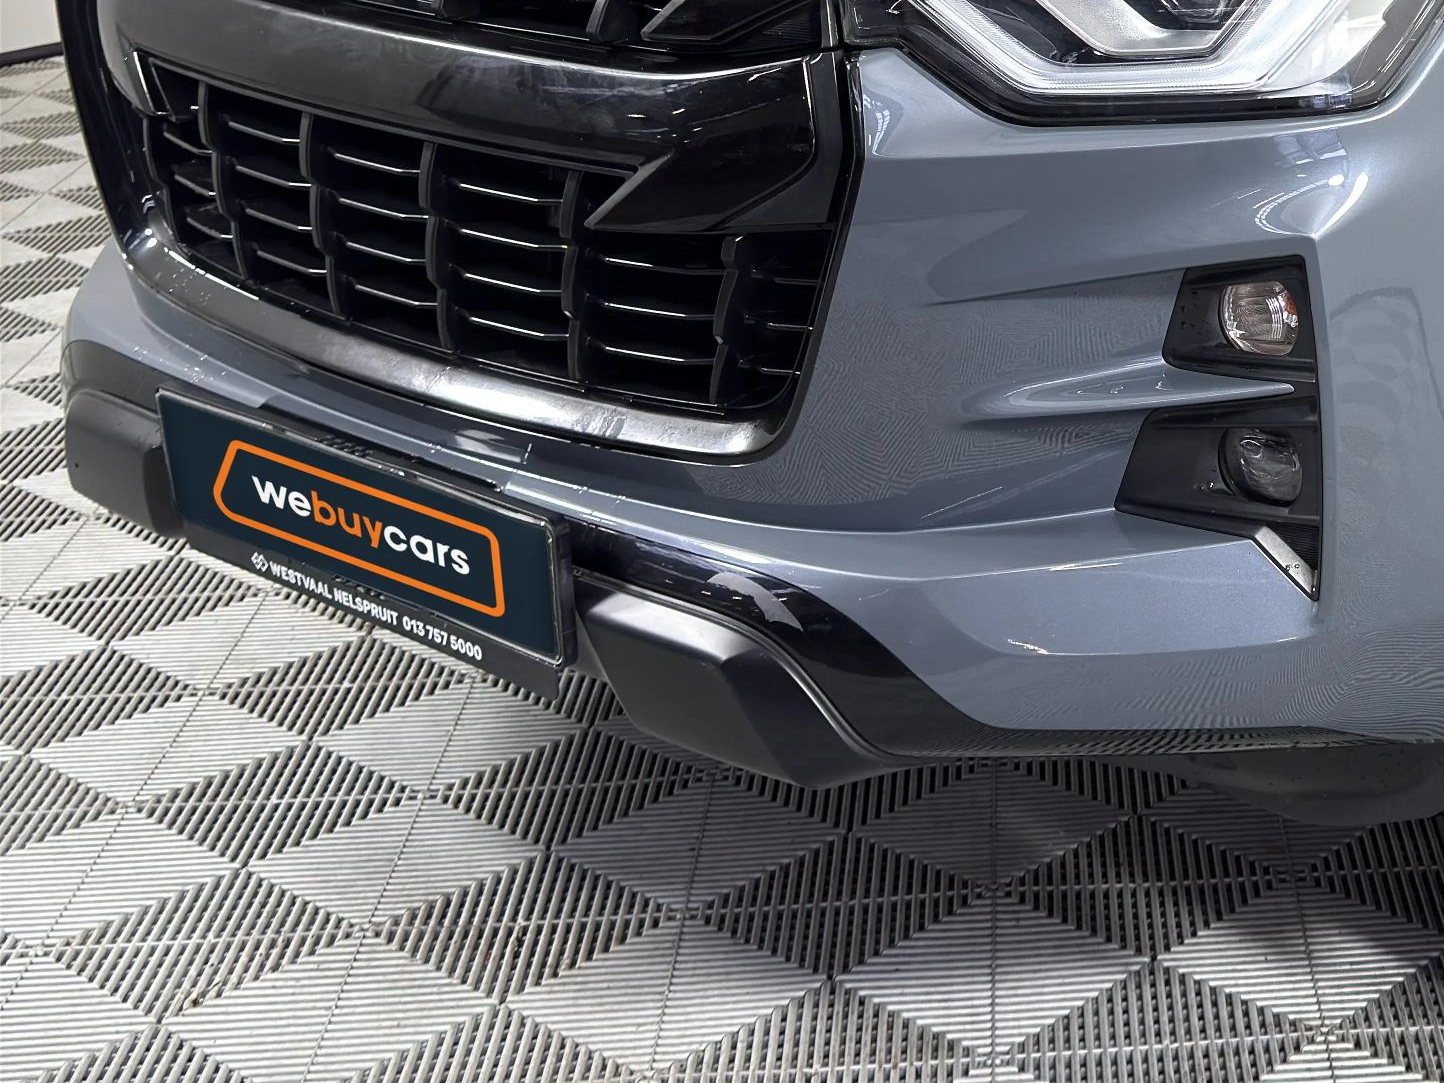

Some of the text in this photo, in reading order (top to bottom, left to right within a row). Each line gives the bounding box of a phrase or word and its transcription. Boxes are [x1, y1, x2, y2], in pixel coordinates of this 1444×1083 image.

[269, 560, 483, 661] WESTVAAL NELSPRUIT 013 757 5000
